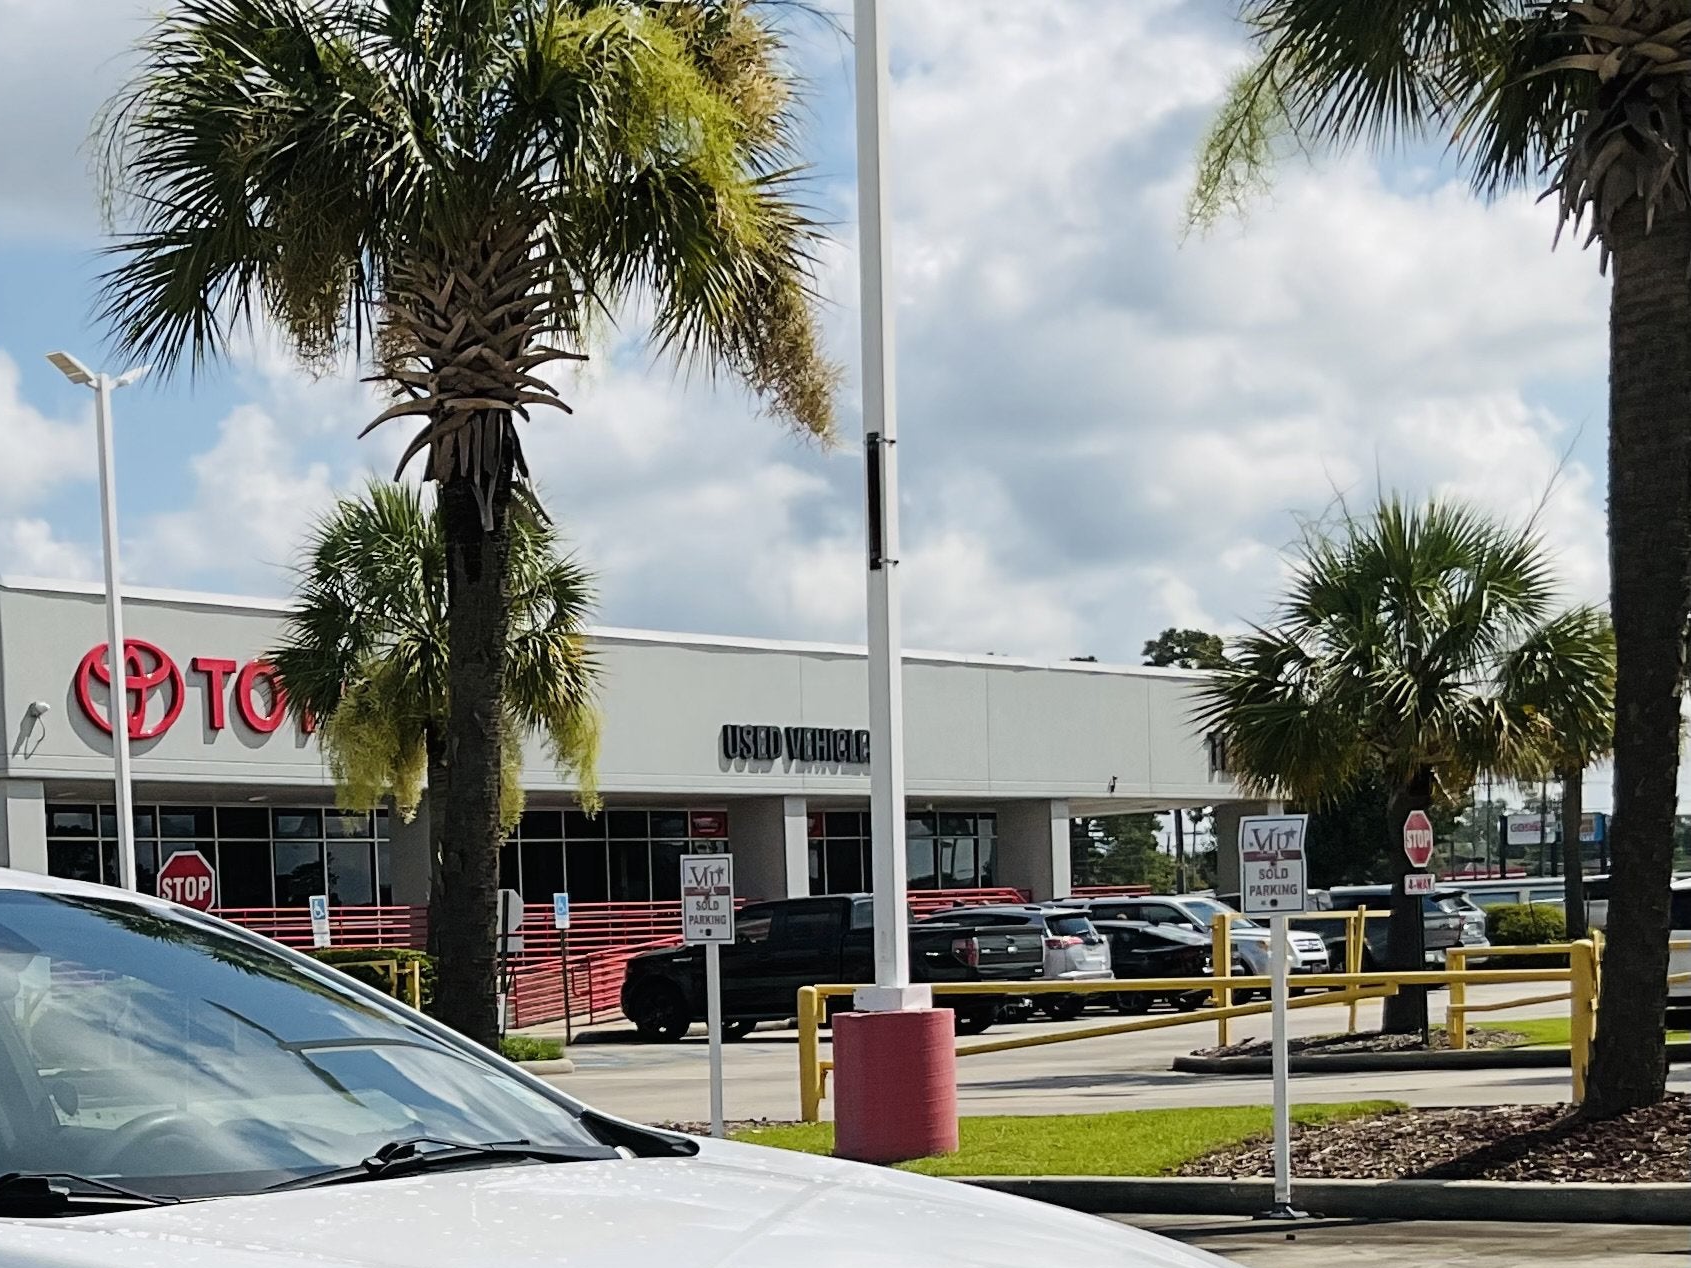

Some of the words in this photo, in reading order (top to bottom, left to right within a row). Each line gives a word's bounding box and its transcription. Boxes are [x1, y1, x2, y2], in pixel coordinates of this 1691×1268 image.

[191, 657, 316, 734] TO
[722, 724, 783, 760] USED
[784, 726, 871, 765] VEHICLE
[1406, 829, 1430, 849] STOP
[1258, 867, 1289, 880] SOLD
[161, 876, 211, 902] STOP
[1249, 883, 1298, 897] PARKING
[695, 900, 720, 911] SOLD
[689, 914, 727, 926] PARKING
